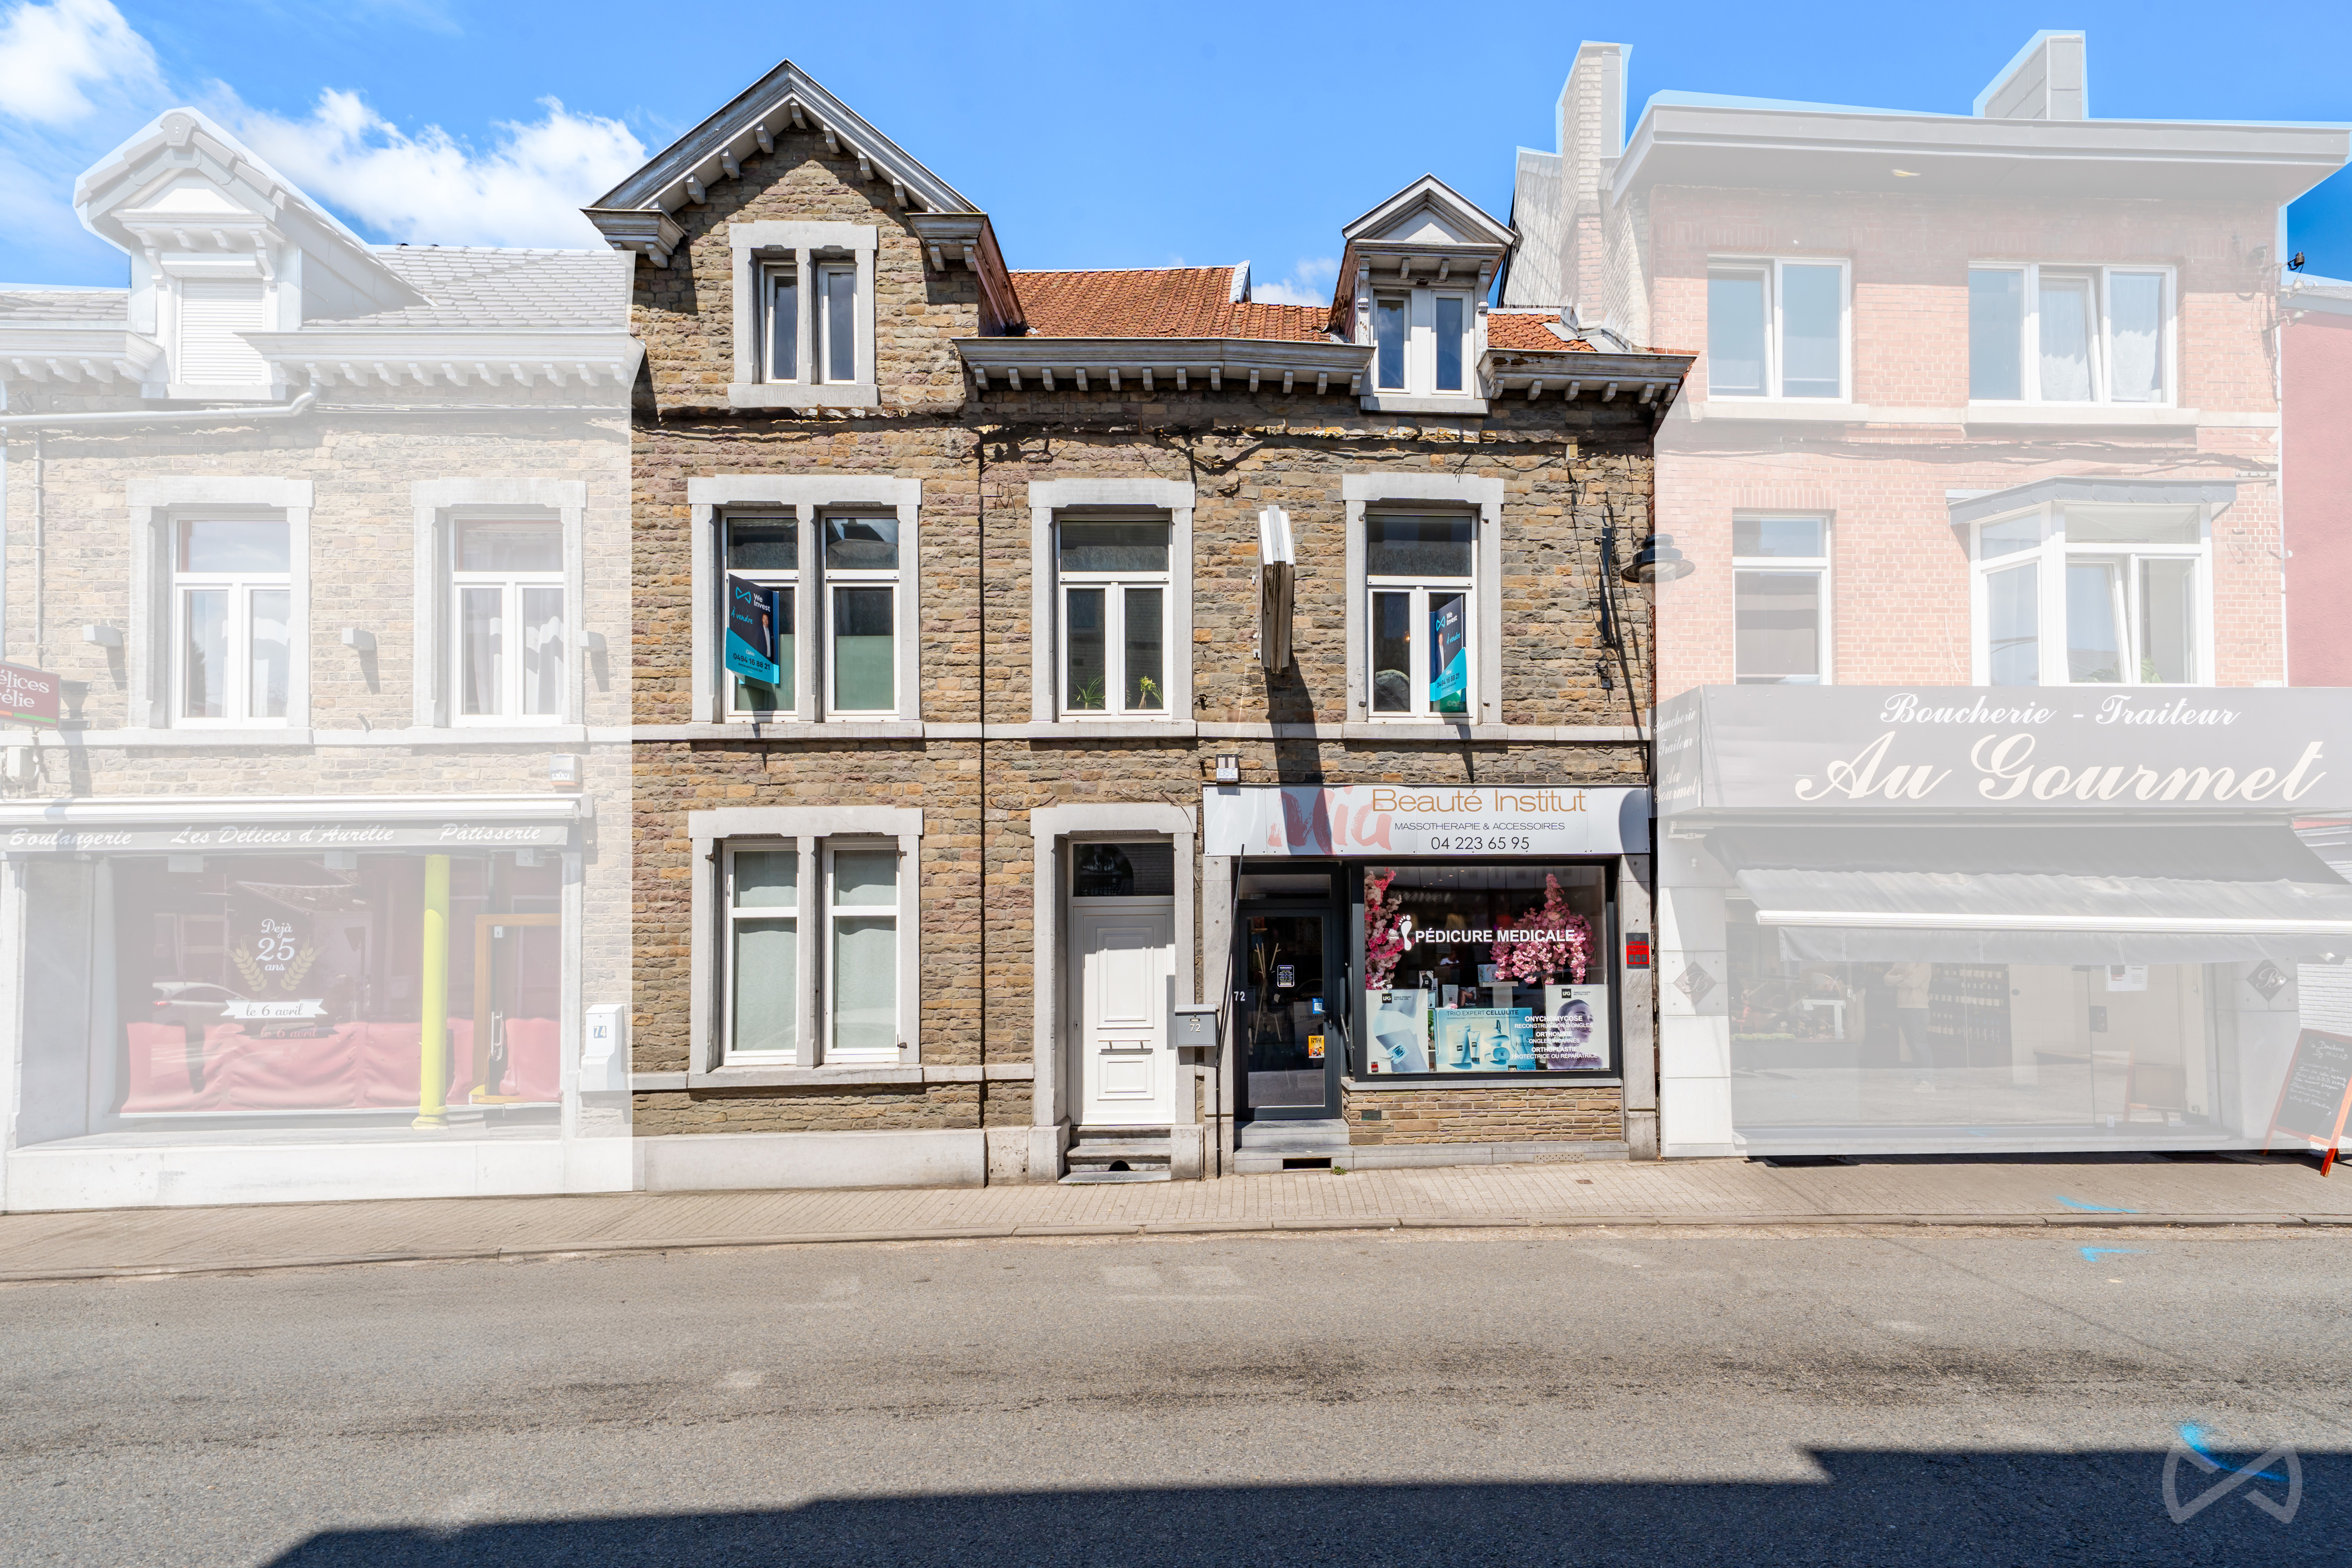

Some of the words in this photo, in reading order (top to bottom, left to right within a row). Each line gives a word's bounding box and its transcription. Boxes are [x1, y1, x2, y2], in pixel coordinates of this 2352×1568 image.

[753, 593, 763, 602] We
[753, 600, 771, 612] Invest
[731, 606, 736, 618] À
[736, 613, 753, 624] vendre
[1446, 611, 1453, 620] We
[1446, 614, 1458, 626] Invest
[1446, 633, 1450, 645] À
[1449, 632, 1461, 643] vendre
[733, 652, 748, 663] 0494
[764, 662, 770, 671] 21
[738, 662, 763, 673] www.weinvest.be
[1436, 679, 1446, 688] 0494
[1446, 676, 1450, 684] 16
[0, 688, 35, 708] élie
[1880, 692, 2057, 724] Boucherie
[2095, 694, 2241, 725] Traiteur
[1653, 708, 1696, 734] Boucherie
[1658, 735, 1694, 756] Traiteur
[1795, 730, 1952, 801] Au
[1971, 733, 2327, 801] Gourmet
[1662, 764, 1682, 787] Au
[1654, 776, 1697, 803] Gourmet
[1372, 788, 1482, 812] Beauté
[1495, 789, 1586, 812] Institut
[1395, 822, 1481, 831] MASSOTHERAPIE
[1492, 822, 1565, 830] ACCESSOIRES
[9, 827, 132, 849] Boulangerie
[170, 826, 210, 844] Les
[217, 825, 292, 843] Délices
[299, 824, 394, 843] d'Aurélie
[439, 823, 541, 840] Pâtisserie
[1431, 837, 1450, 850] 04
[1455, 837, 1483, 850] 223
[1488, 837, 1506, 850] 65
[1511, 837, 1530, 850] 95
[261, 918, 293, 939] Dejà
[1415, 928, 1493, 943] PÉDICURE
[1497, 929, 1575, 943] MEDICALE
[255, 937, 295, 961] 25
[1233, 991, 1245, 1001] 72
[246, 1003, 257, 1016] le
[261, 1004, 270, 1016] 6
[275, 1002, 304, 1016] avril
[594, 1026, 606, 1037] 74
[1190, 1024, 1200, 1032] 72
